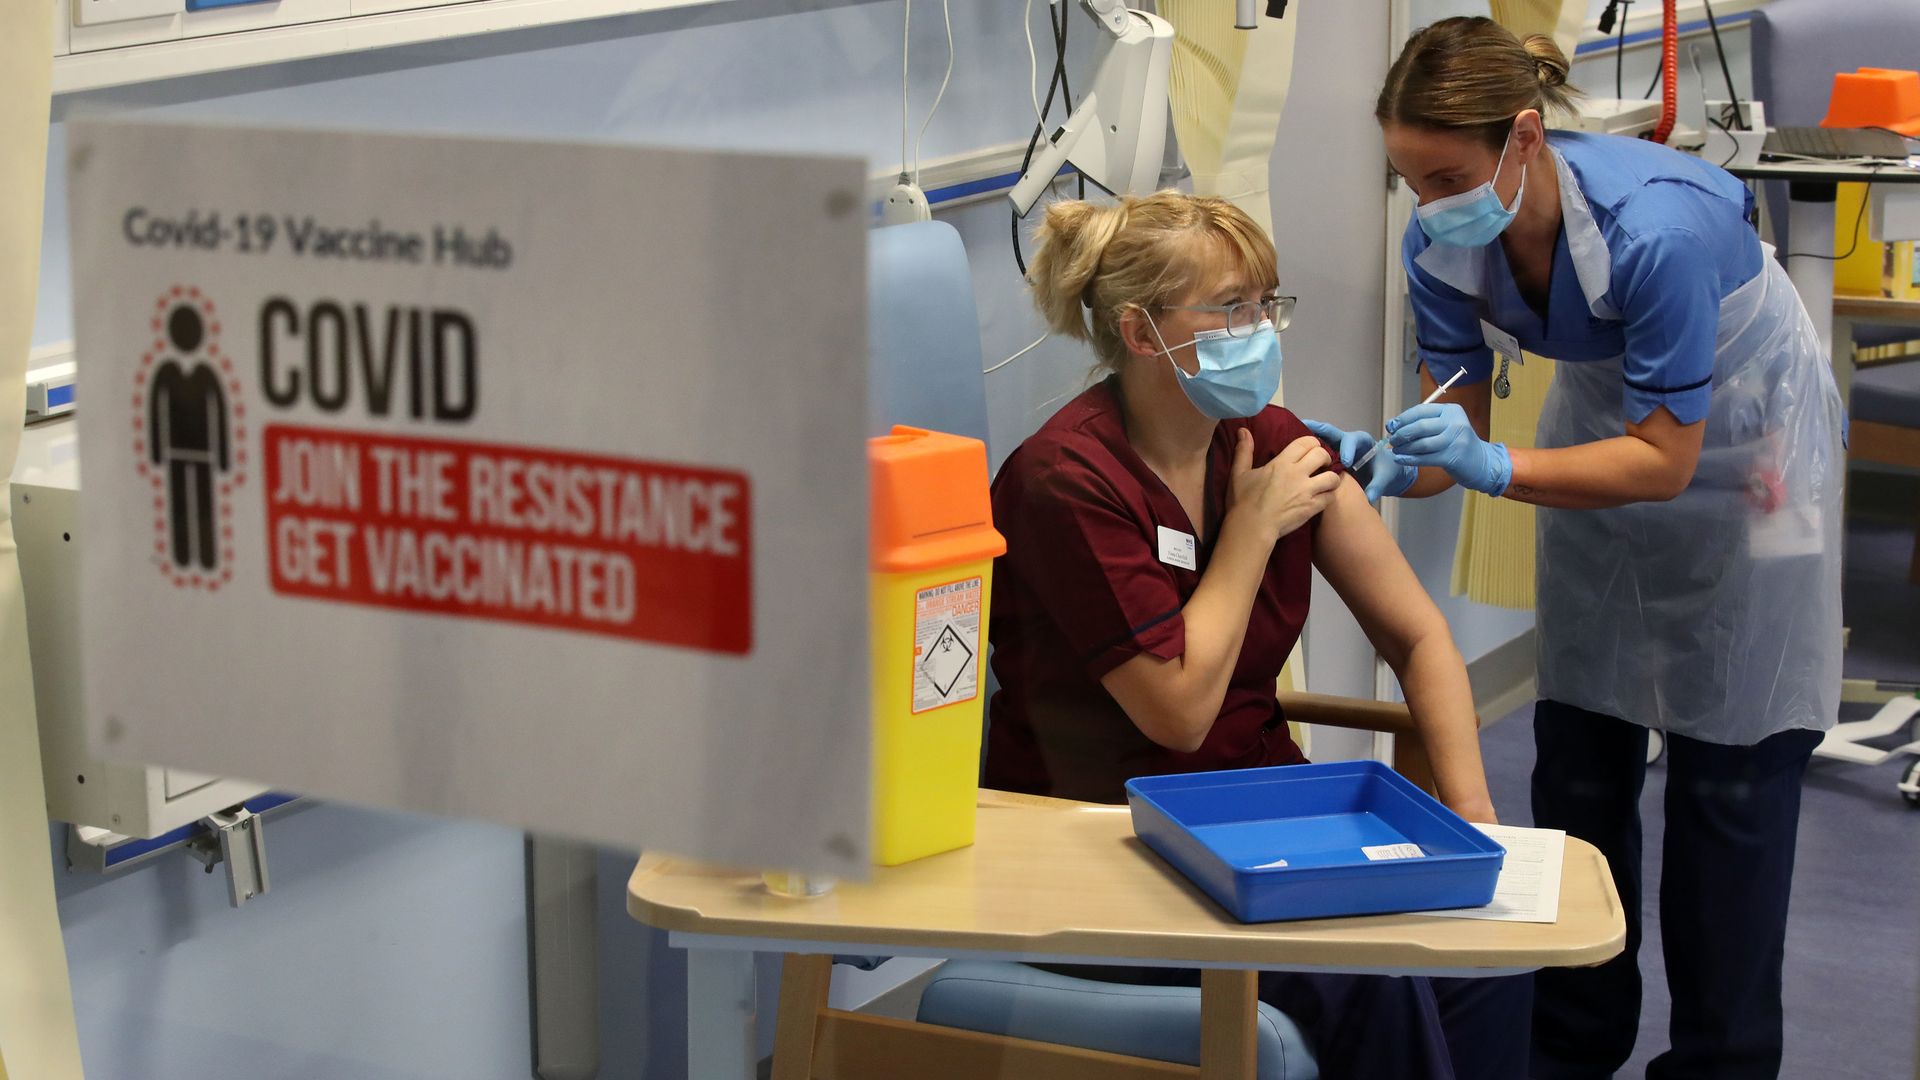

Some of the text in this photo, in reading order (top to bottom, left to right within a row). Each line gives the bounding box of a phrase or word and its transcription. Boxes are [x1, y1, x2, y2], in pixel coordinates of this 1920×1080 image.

[125, 208, 512, 269] Covid-19 Vaccine Hub
[261, 298, 477, 421] COVID
[277, 440, 738, 554] JOIN THE RESISTANCE
[277, 519, 636, 622] GET VACCINATED
[952, 600, 979, 616] DANGER
